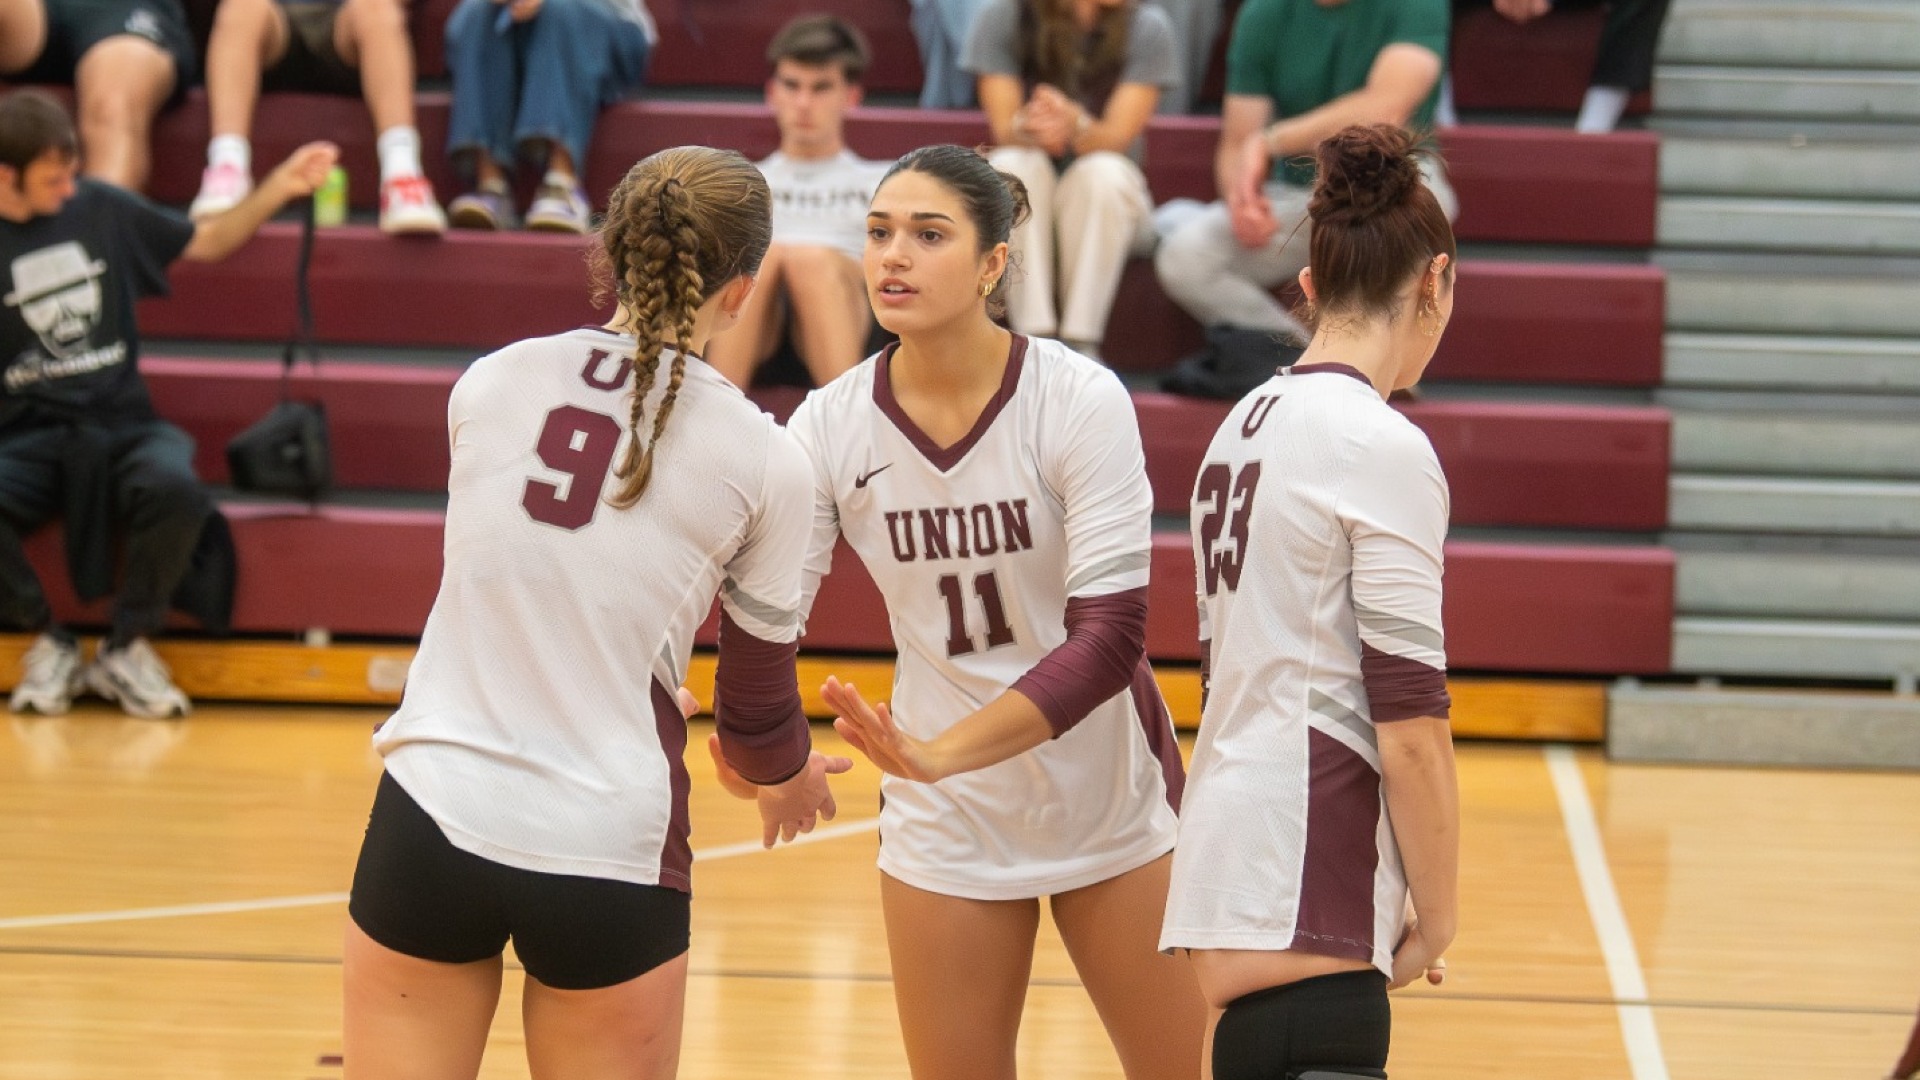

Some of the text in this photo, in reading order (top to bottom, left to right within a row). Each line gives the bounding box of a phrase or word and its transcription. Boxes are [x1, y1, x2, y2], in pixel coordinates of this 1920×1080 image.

[580, 347, 635, 391] U
[1241, 394, 1282, 439] U
[520, 403, 624, 533] 9
[884, 498, 1033, 562] UNION
[1197, 459, 1262, 597] 23
[937, 569, 1017, 659] 11
